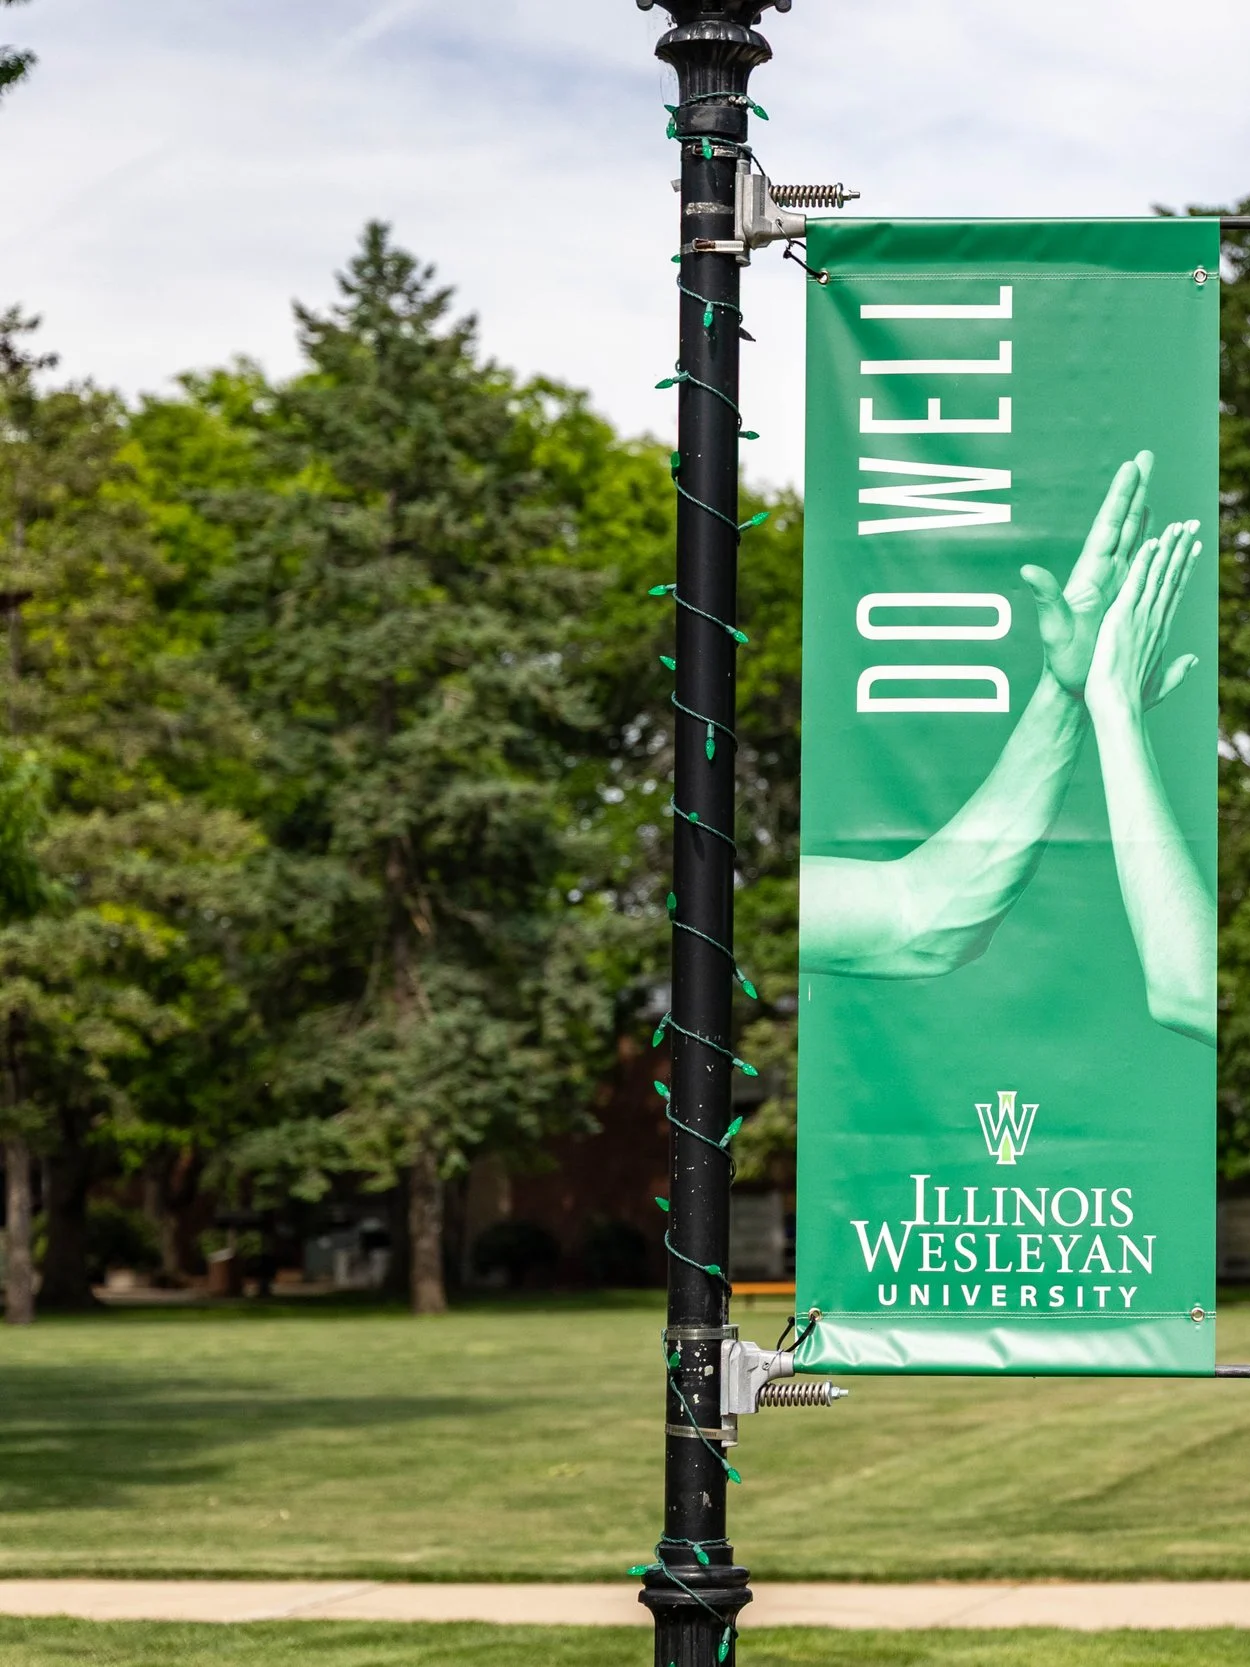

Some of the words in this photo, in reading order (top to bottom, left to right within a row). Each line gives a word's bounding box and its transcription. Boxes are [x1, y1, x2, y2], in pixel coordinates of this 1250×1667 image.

[858, 285, 1013, 535] WELL
[856, 592, 1012, 713] DO
[910, 1174, 1134, 1228] ILLINOIS
[850, 1220, 1157, 1274] WESLEYAN
[878, 1284, 1138, 1308] UNIVERSITY
